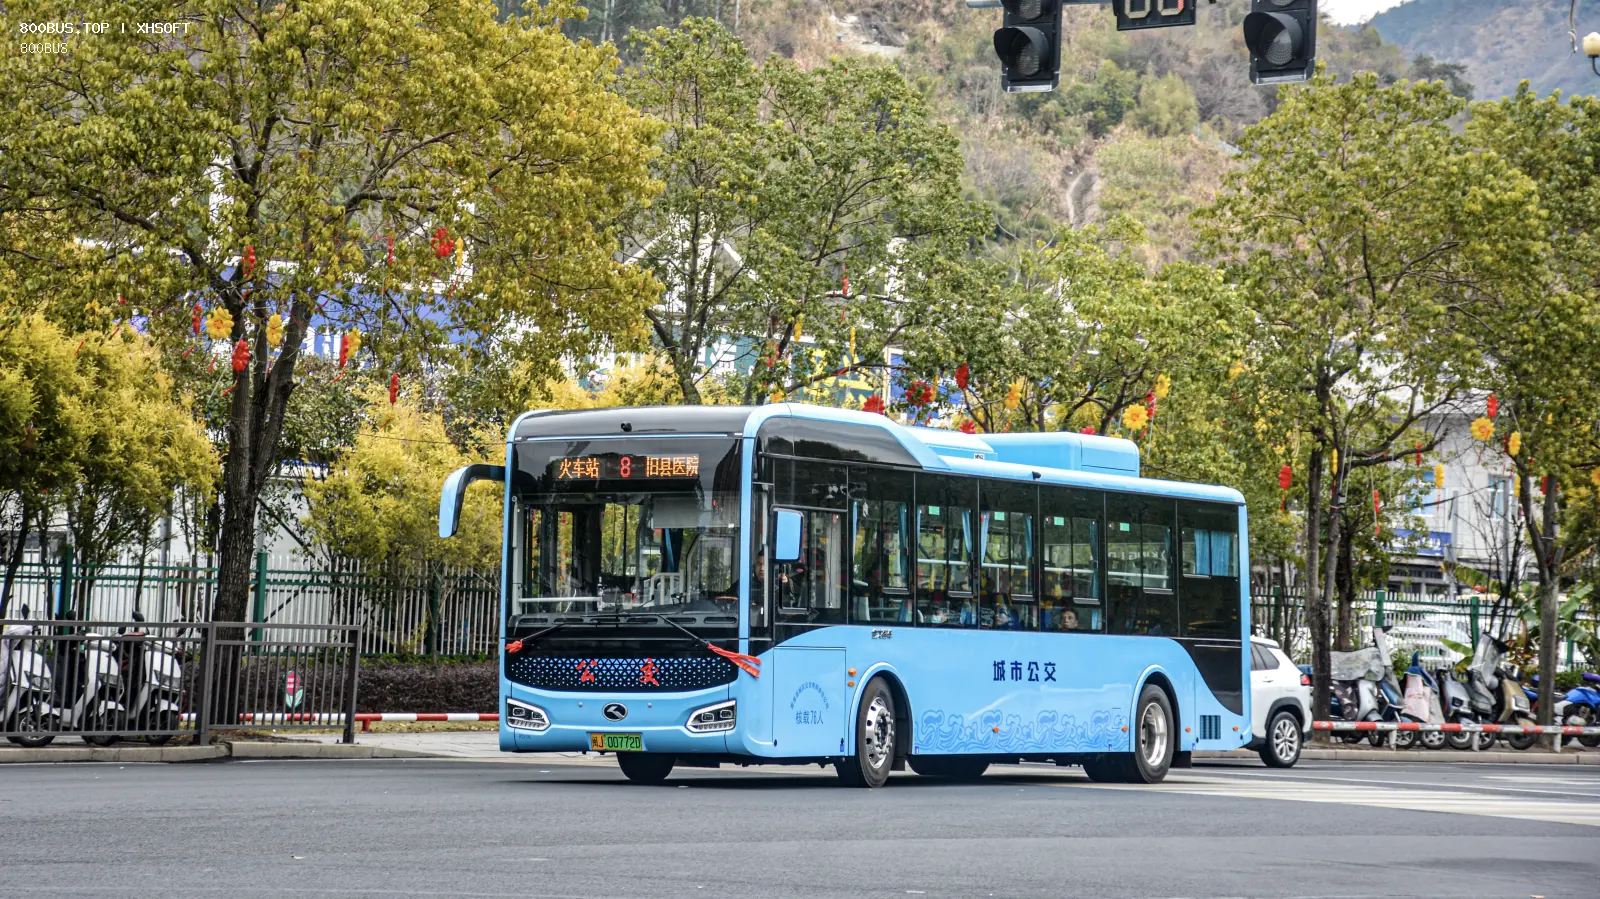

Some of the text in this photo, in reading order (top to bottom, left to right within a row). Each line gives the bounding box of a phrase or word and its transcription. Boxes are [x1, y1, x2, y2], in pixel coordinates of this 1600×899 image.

[558, 457, 600, 479] 火车站
[620, 456, 631, 478] 8
[992, 660, 1057, 682] 城市公交
